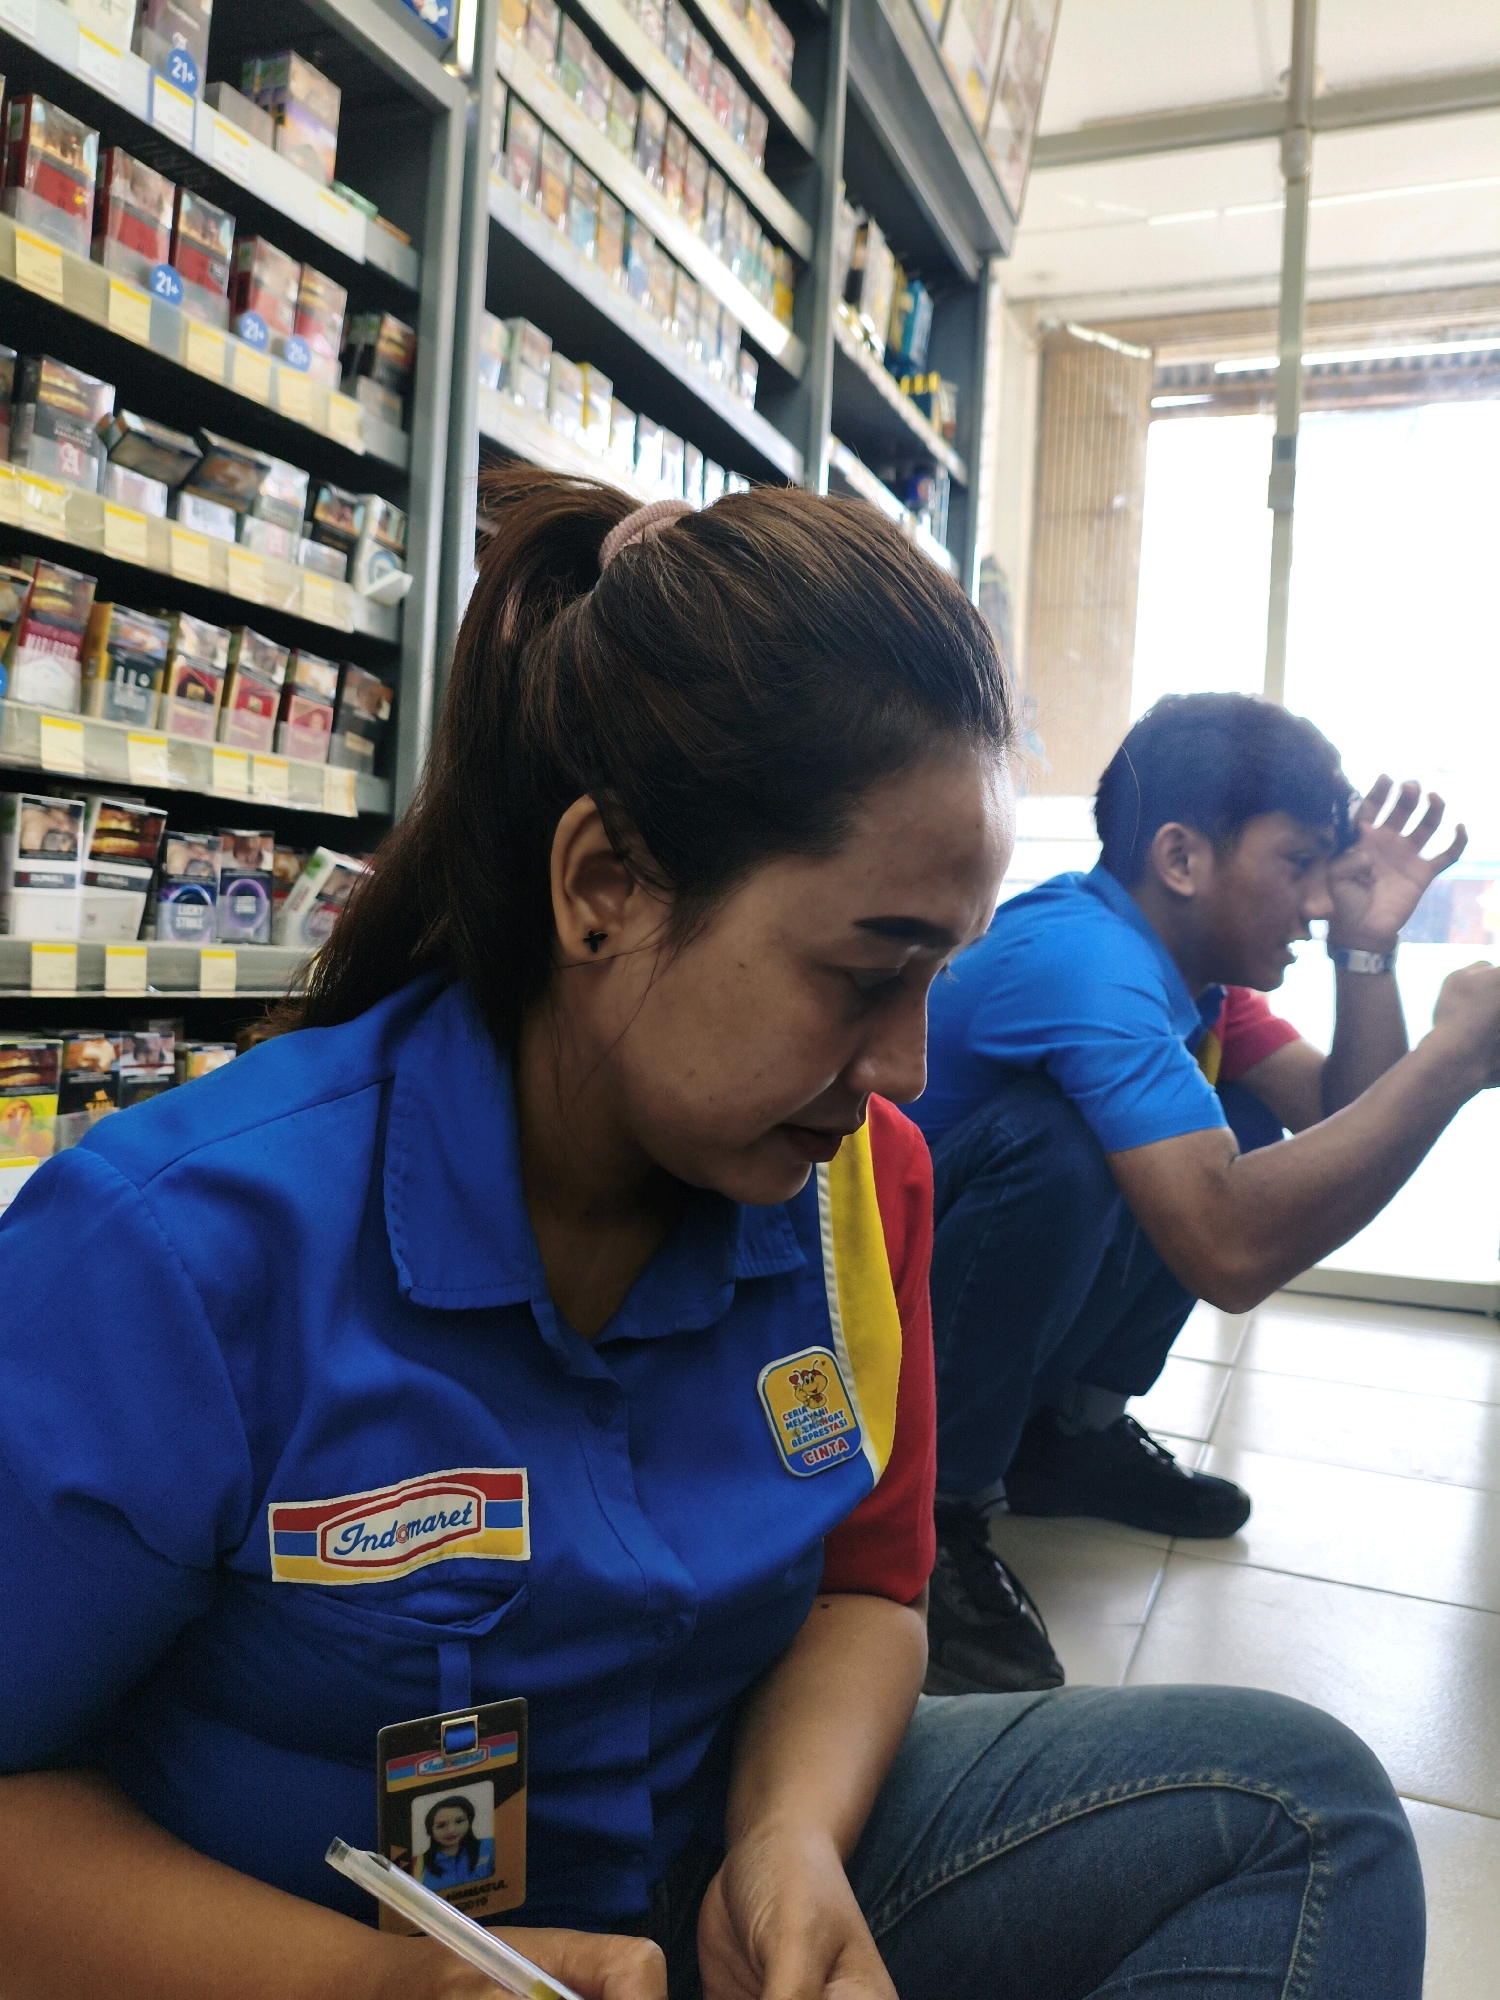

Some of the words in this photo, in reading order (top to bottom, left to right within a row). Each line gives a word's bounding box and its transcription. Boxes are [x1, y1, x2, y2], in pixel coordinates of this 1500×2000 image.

[172, 56, 196, 83] 21+
[155, 271, 179, 297] 21+
[782, 1405, 808, 1421] CERIA
[791, 1417, 848, 1448] BERPRESTASI
[803, 1438, 848, 1464] CINTA
[333, 1501, 473, 1556] Indomaret
